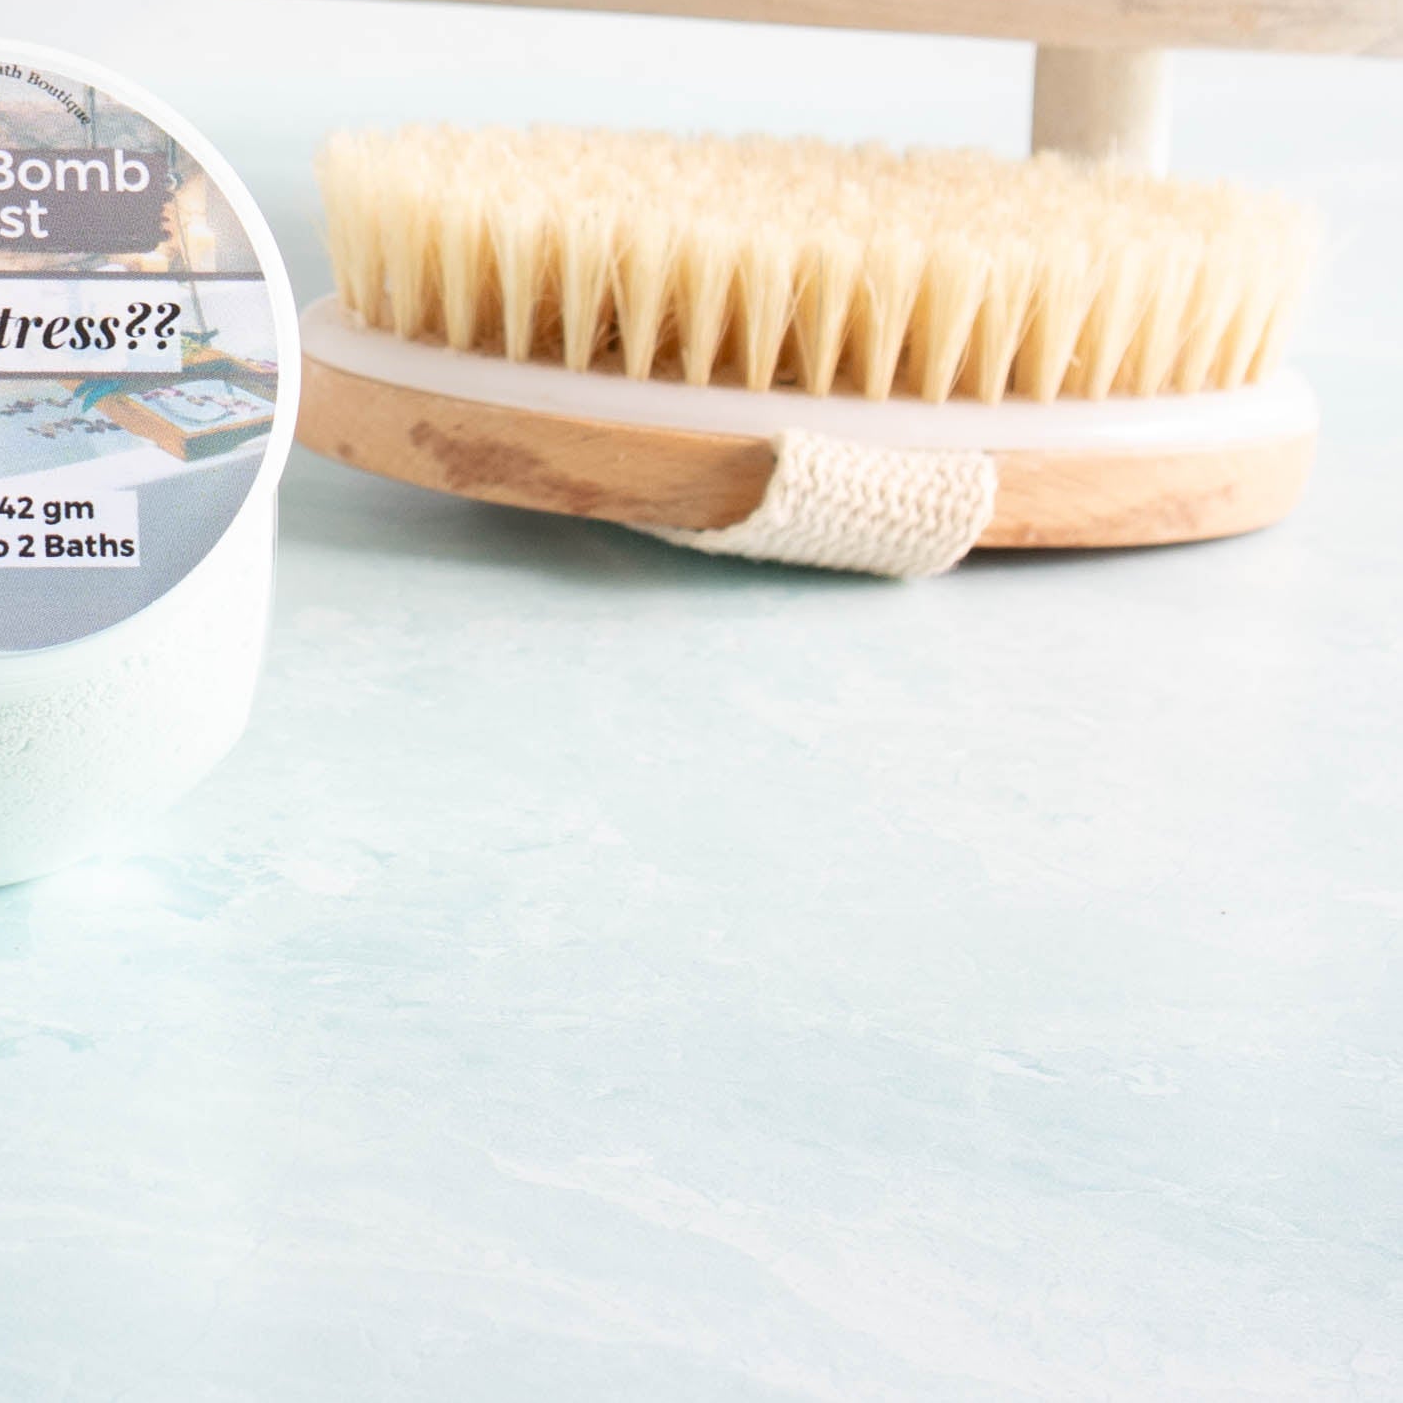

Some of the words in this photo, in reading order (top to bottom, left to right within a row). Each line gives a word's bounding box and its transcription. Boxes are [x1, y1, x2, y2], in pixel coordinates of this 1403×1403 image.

[27, 71, 92, 126] Boutique
[43, 500, 95, 525] gm
[17, 535, 36, 558] 2
[45, 534, 135, 558] Baths
